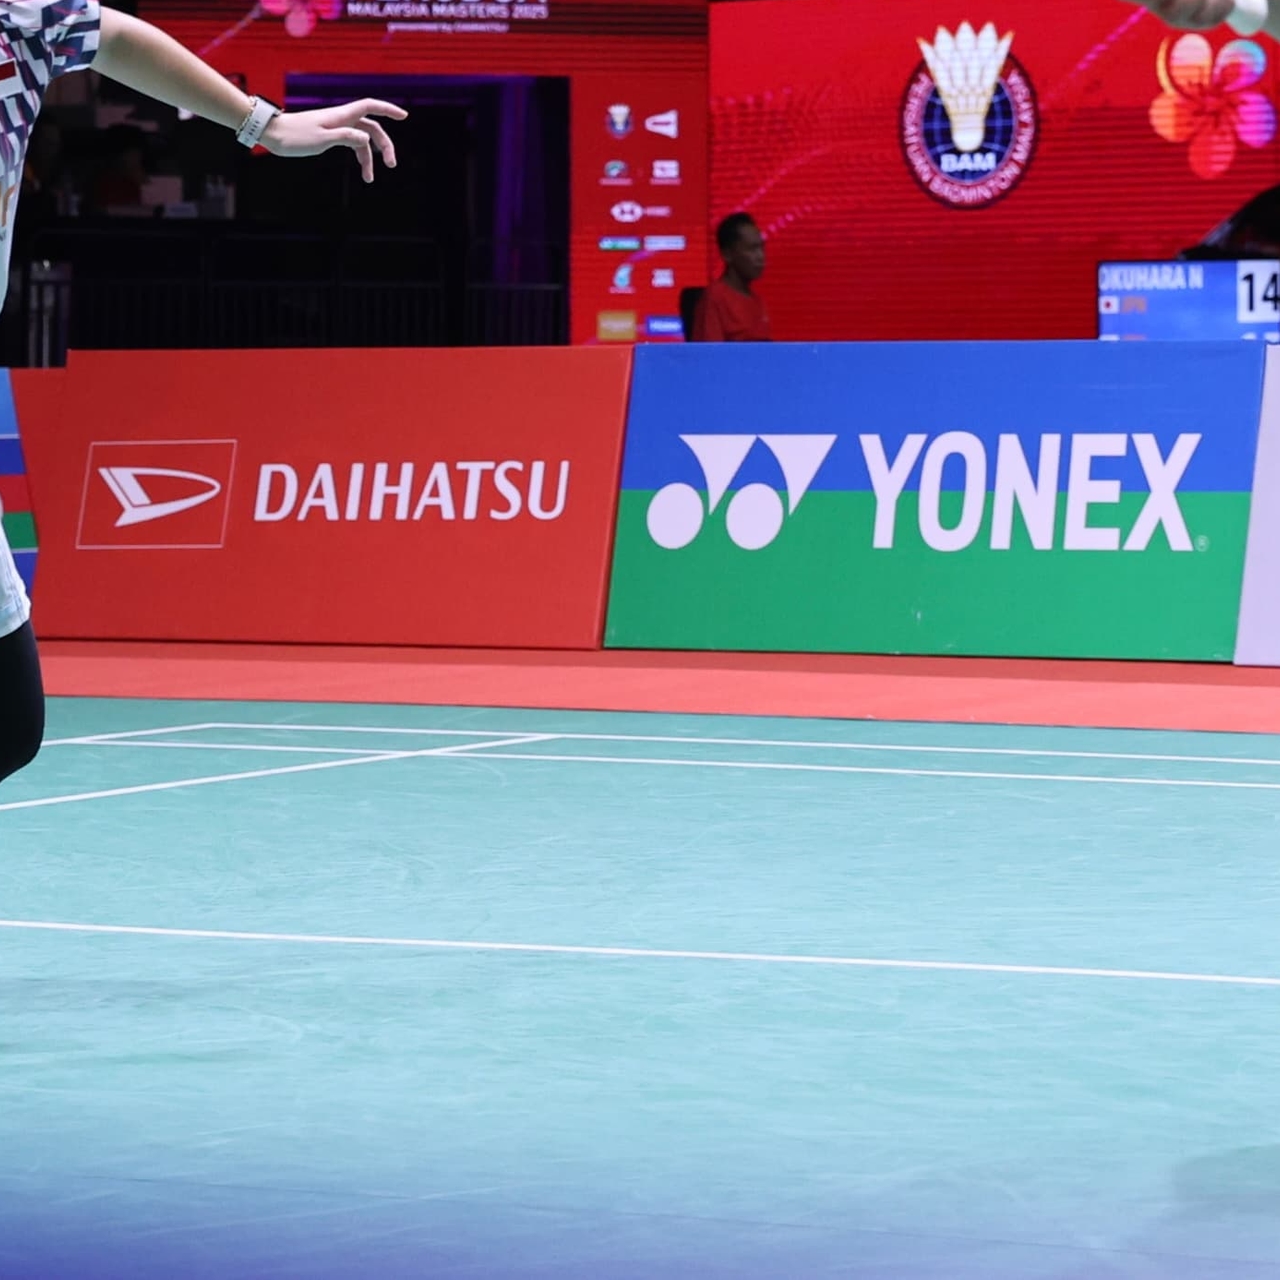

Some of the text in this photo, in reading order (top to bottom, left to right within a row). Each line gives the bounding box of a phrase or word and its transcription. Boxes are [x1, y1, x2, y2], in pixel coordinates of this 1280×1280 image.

[940, 152, 997, 173] BAM
[253, 460, 569, 522] DAIHATSU
[859, 431, 1202, 552] YONEX
